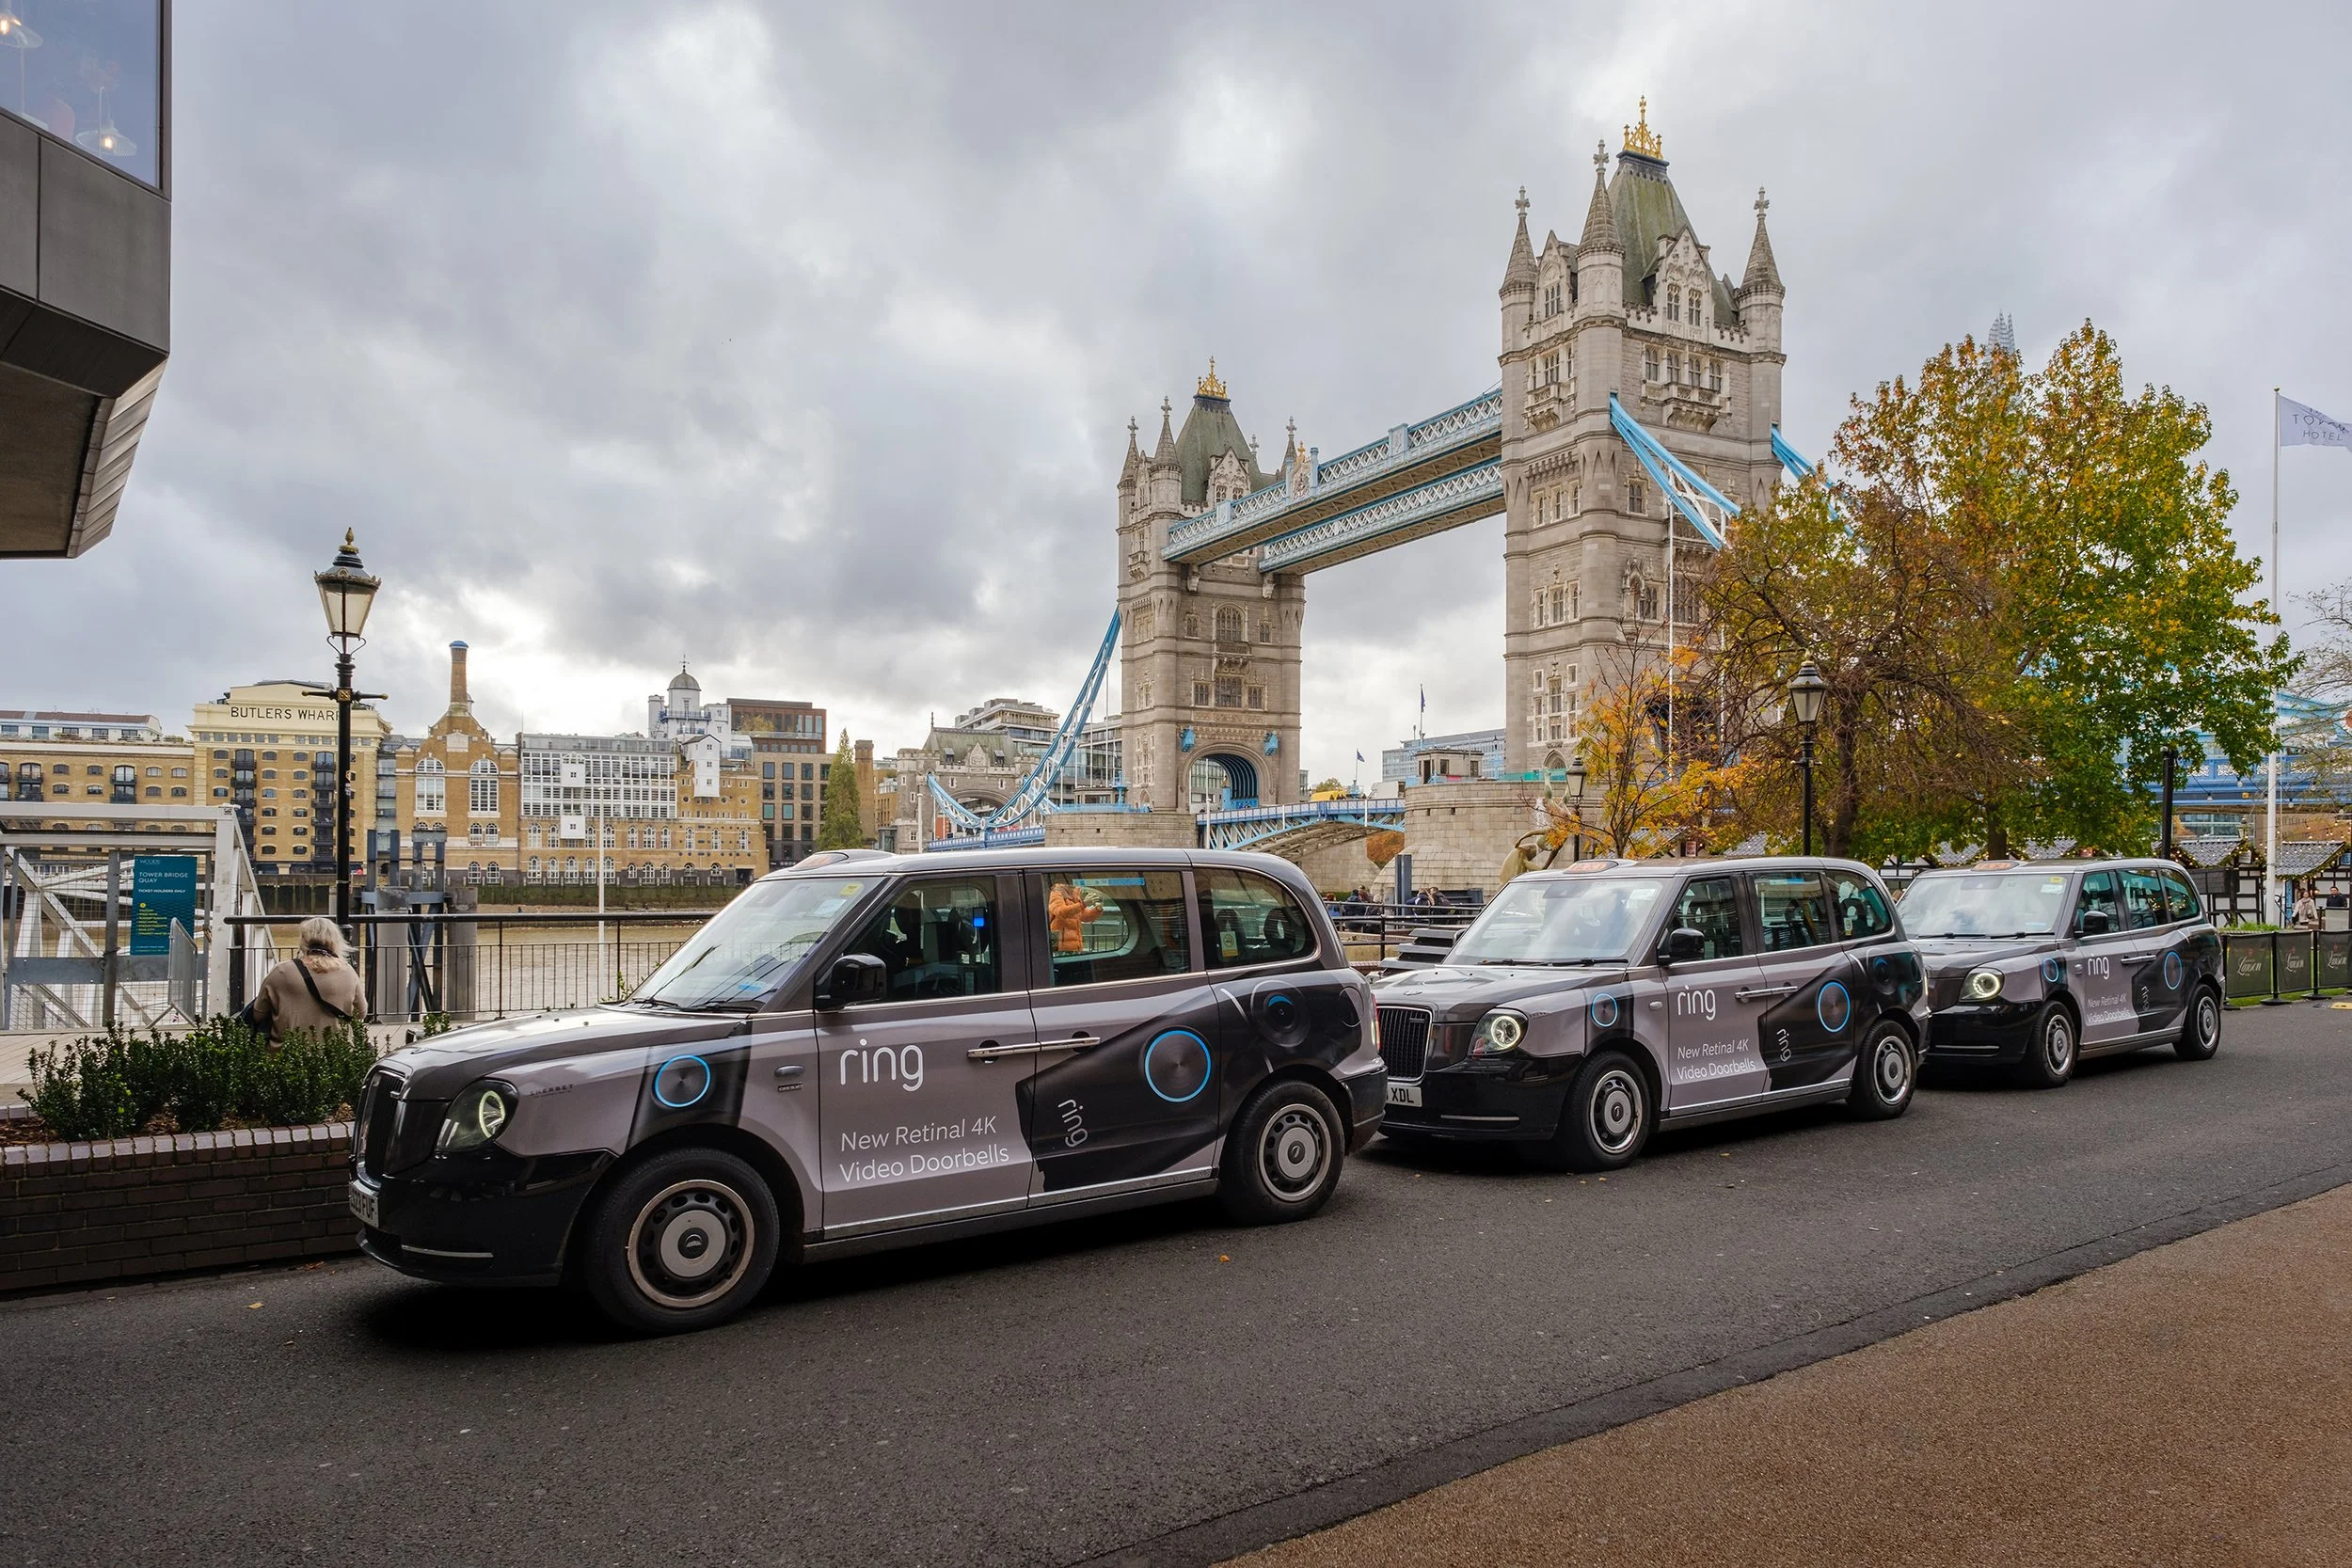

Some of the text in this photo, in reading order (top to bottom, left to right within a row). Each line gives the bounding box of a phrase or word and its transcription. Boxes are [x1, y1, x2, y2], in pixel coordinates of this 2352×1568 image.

[2303, 430, 2342, 441] HOTEL
[230, 706, 292, 720] BUTLERS
[2088, 953, 2109, 979] ring
[1677, 985, 1716, 1021] ring
[2088, 998, 2101, 1008] New
[2101, 994, 2120, 1006] Retinal
[2087, 1007, 2131, 1023] Video Doorbells
[1677, 1038, 1749, 1060] New Retinal 4K
[1776, 1028, 1791, 1062] ring
[840, 1038, 924, 1092] ring
[1677, 1058, 1756, 1080] Video Doorbells
[1391, 1086, 1415, 1103] XDL
[841, 1116, 997, 1152] New Retinal 4K
[1057, 1099, 1089, 1148] ring
[839, 1144, 1009, 1182] Video Doorbells
